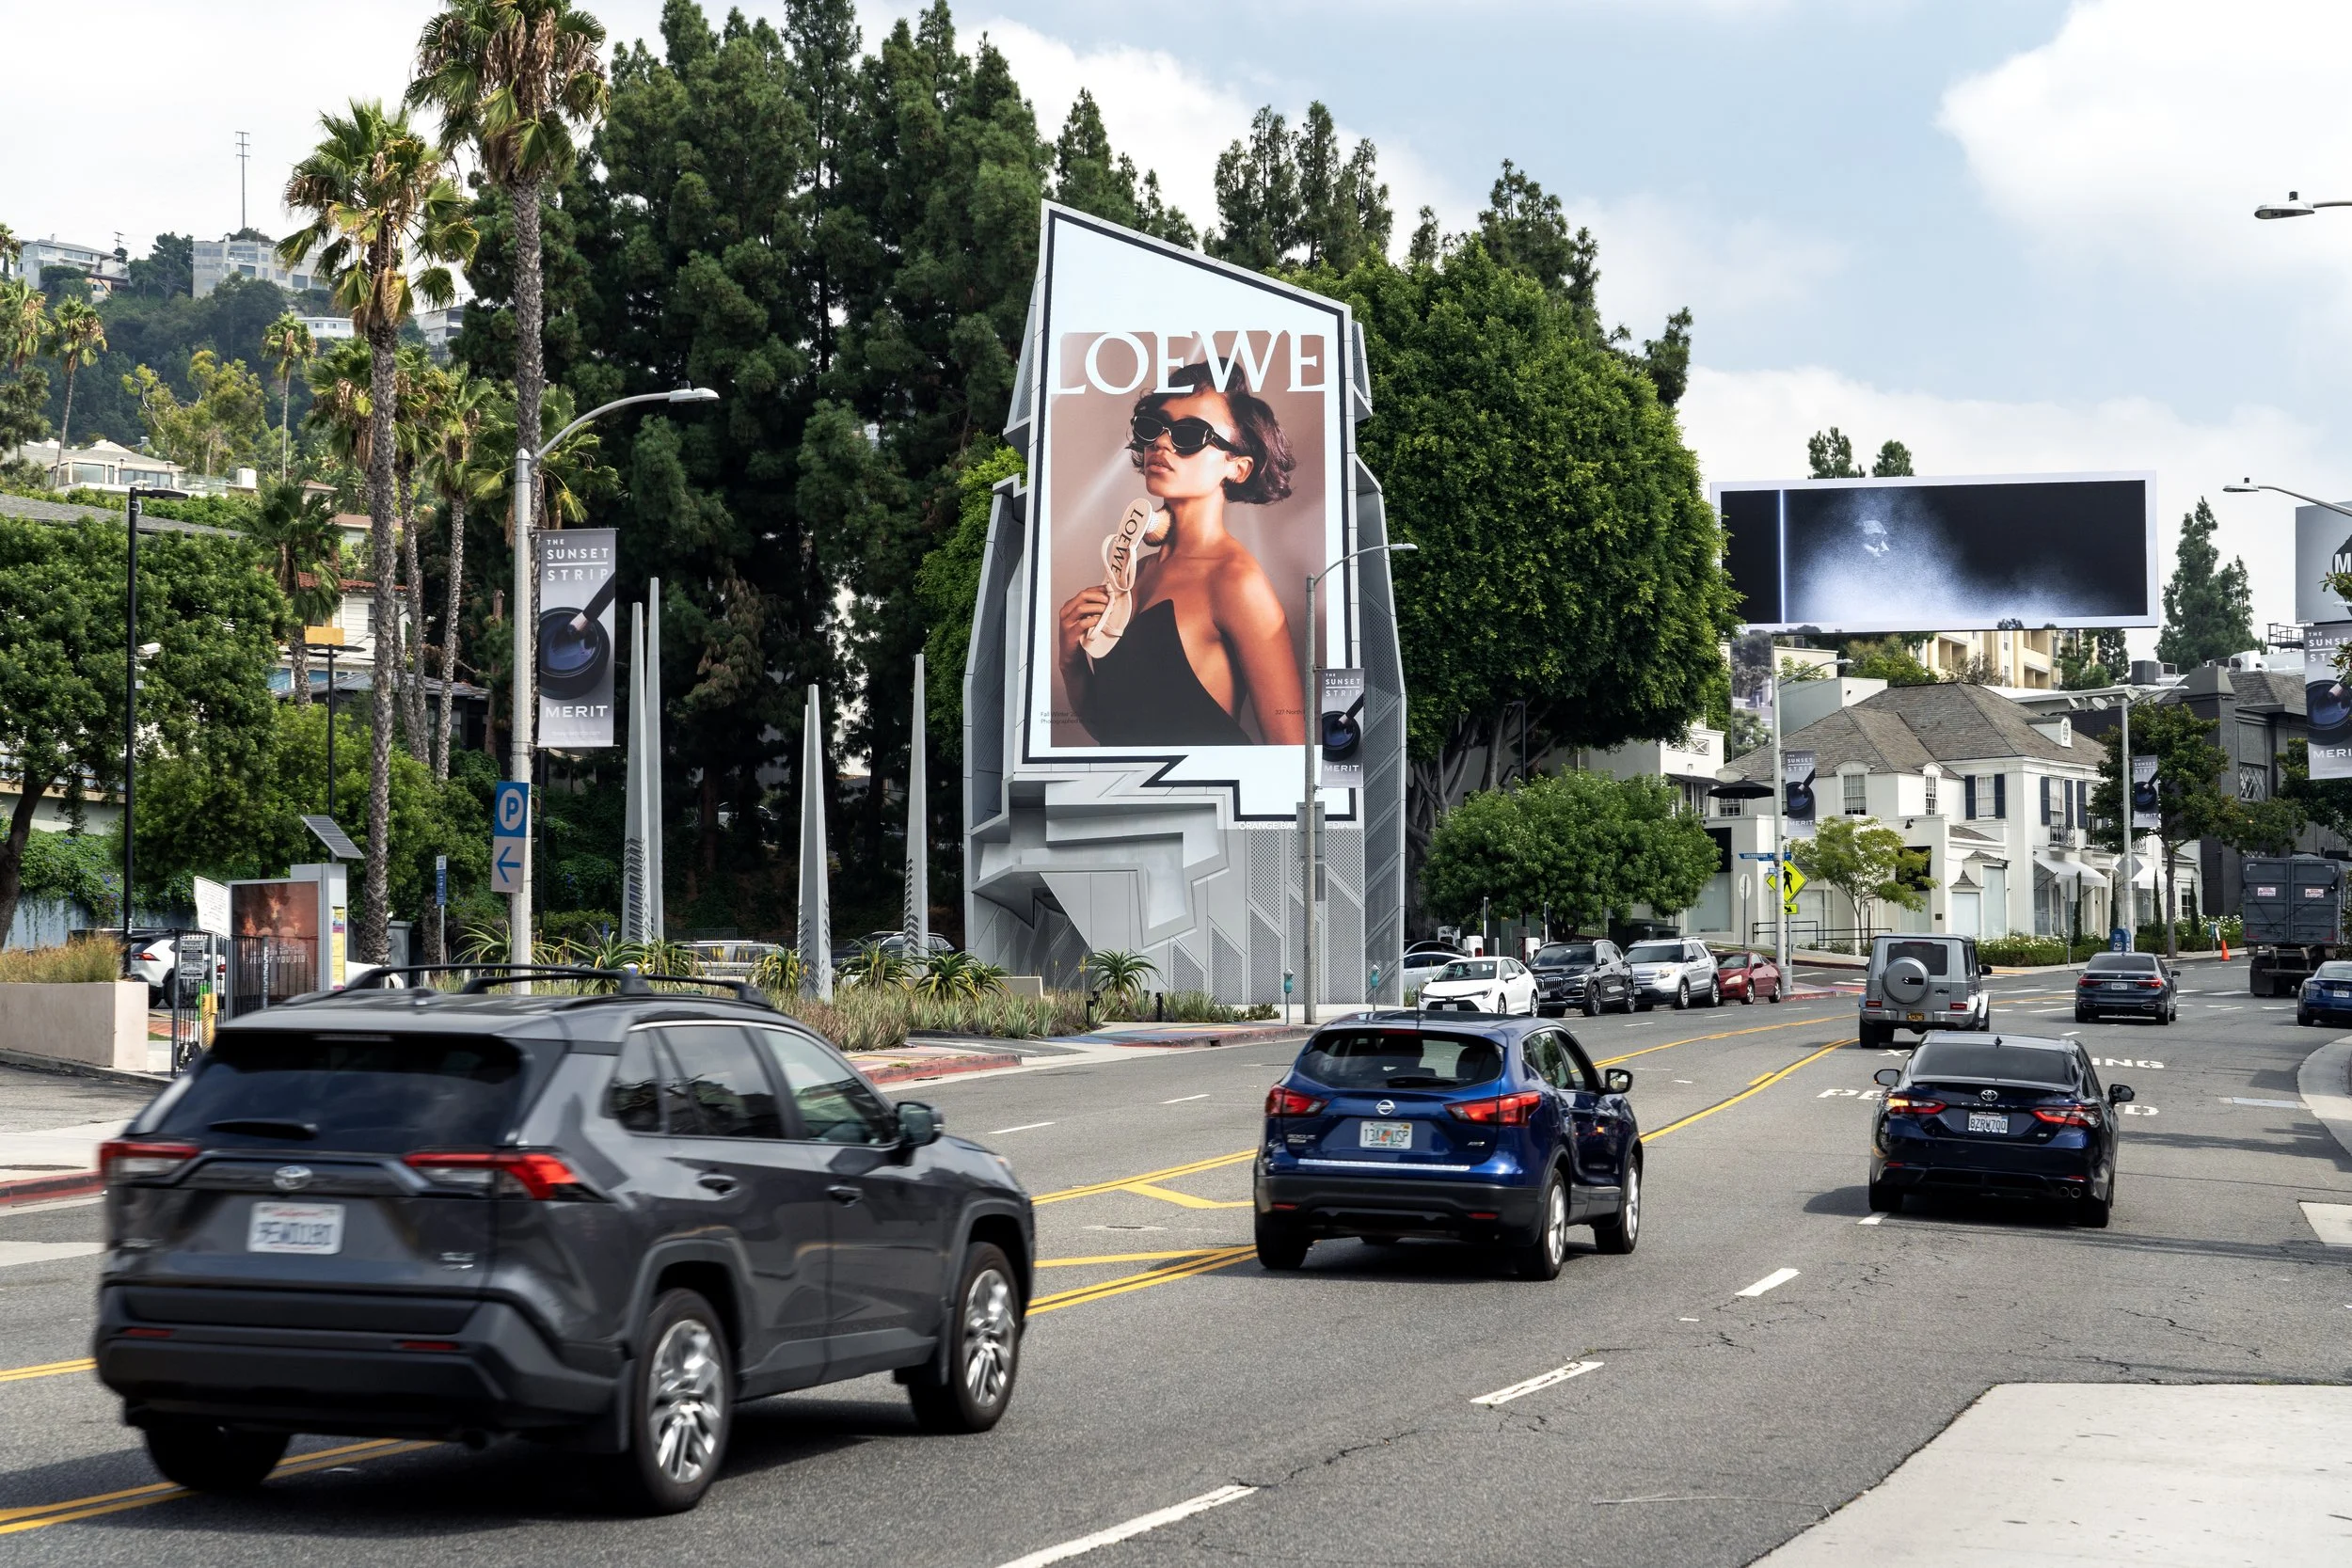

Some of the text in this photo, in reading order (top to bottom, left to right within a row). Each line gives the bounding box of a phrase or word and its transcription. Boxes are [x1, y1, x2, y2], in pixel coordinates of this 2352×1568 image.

[1050, 330, 1325, 395] LOEWE
[1111, 508, 1144, 578] LOEWE
[547, 548, 609, 560] SUNSET
[548, 569, 609, 581] STRIP
[2309, 638, 2349, 647] SUNSE
[546, 705, 608, 718] MERIT
[2313, 749, 2351, 759] MERI
[505, 796, 520, 822] P
[2091, 1057, 2165, 1069] ING
[1816, 1088, 1883, 1101] PE
[1970, 1118, 2007, 1131] 8ZRW700
